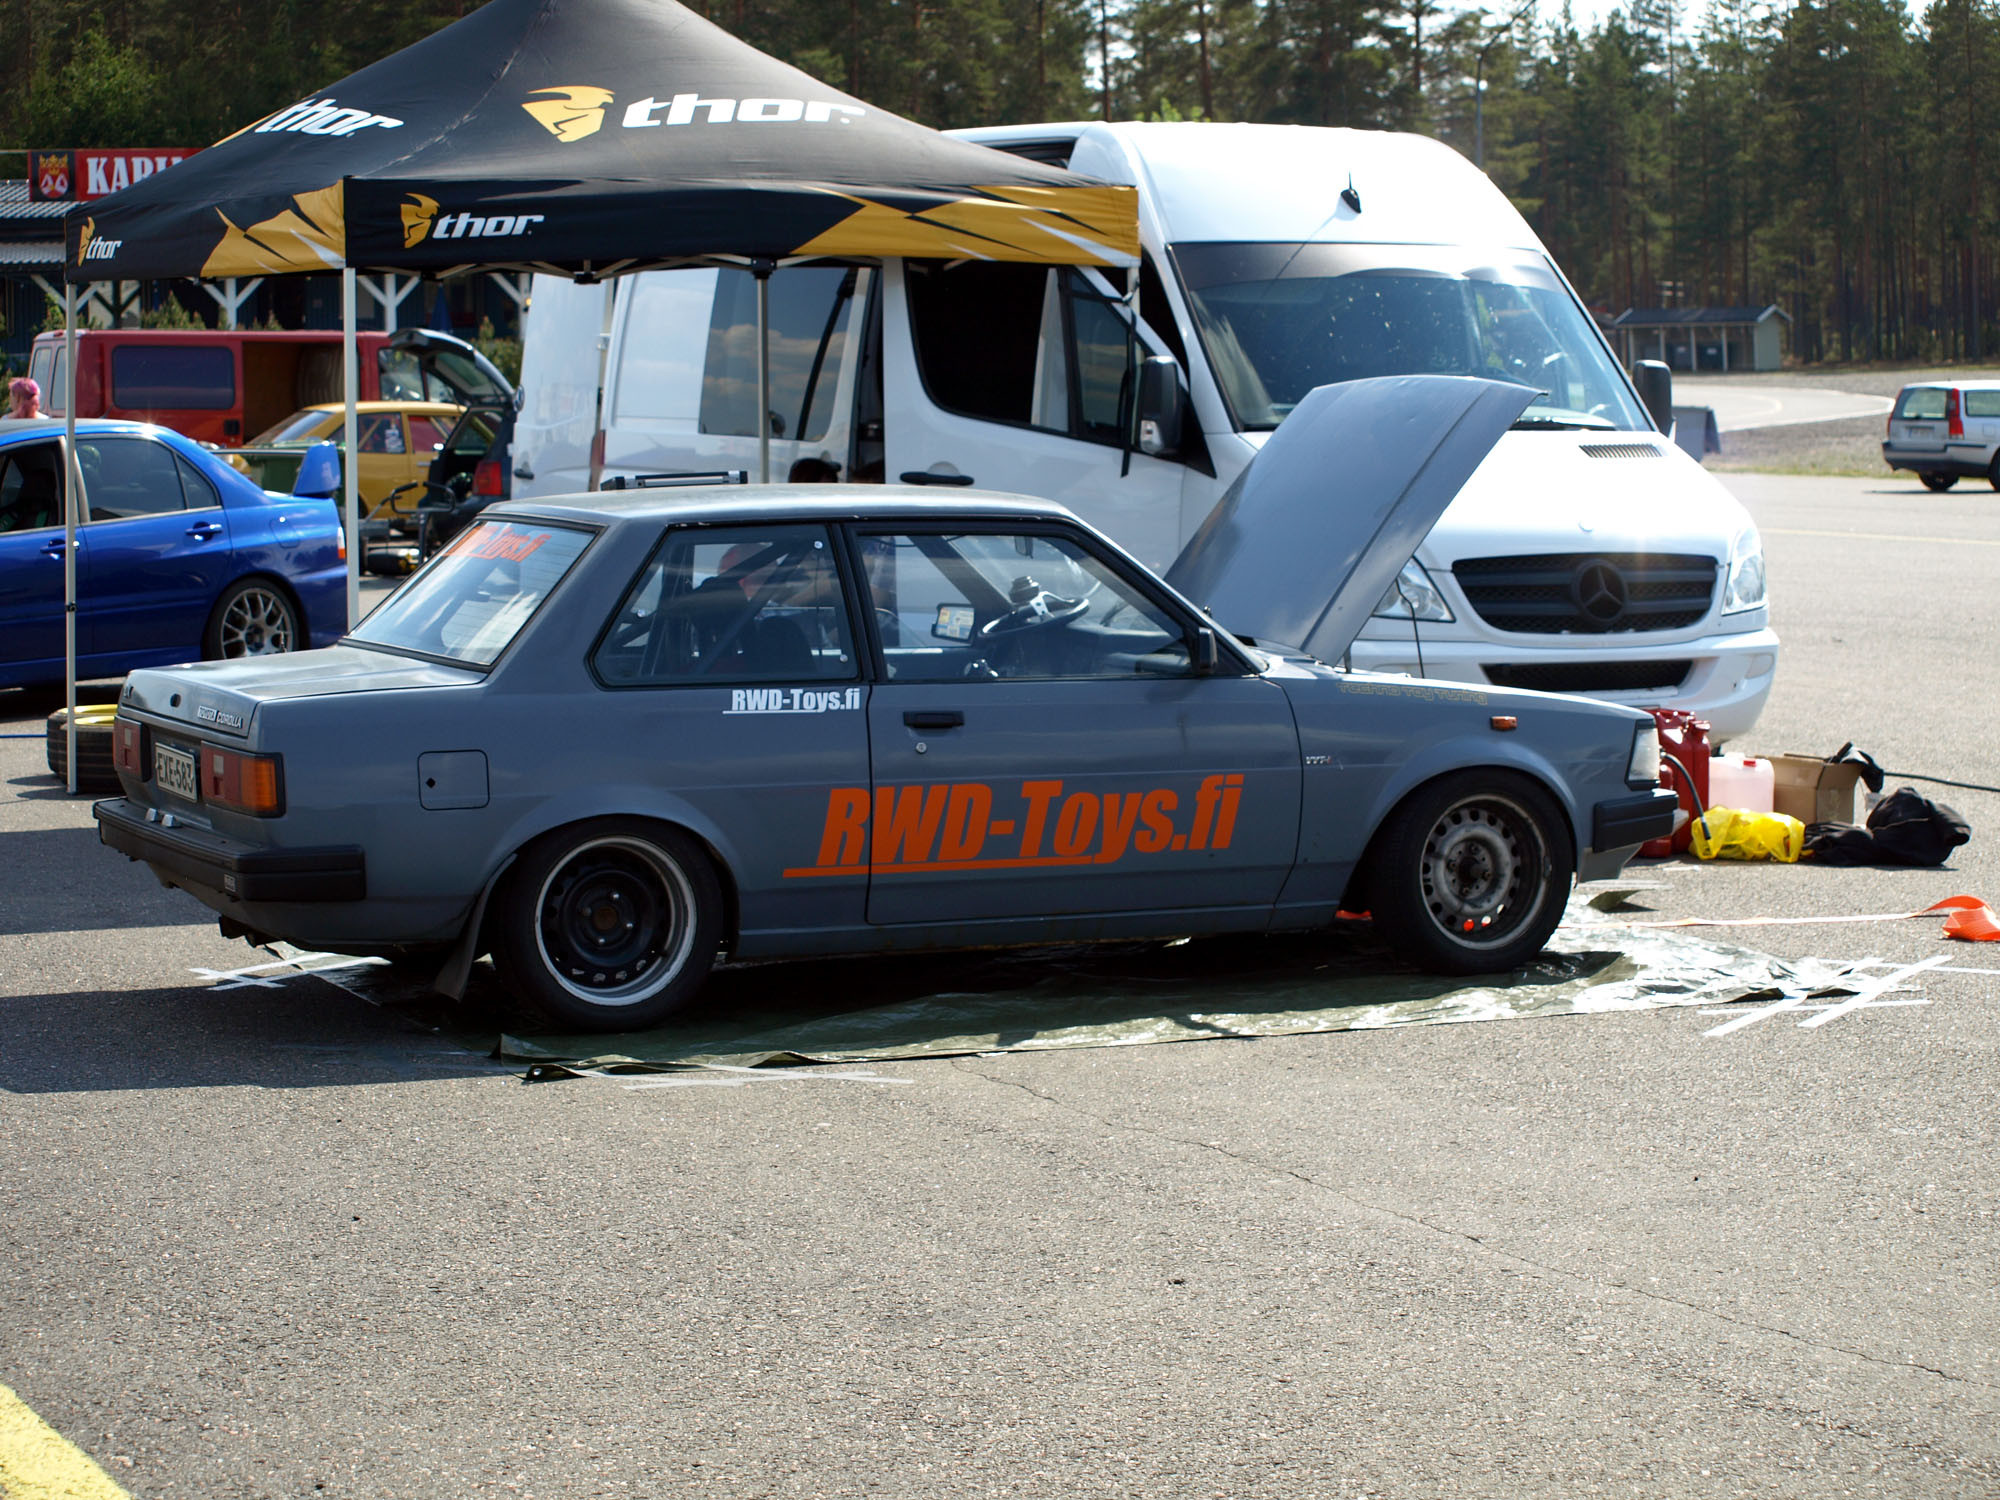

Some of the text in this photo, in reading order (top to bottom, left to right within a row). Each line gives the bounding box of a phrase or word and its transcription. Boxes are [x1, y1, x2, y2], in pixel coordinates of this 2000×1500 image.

[254, 98, 404, 138] thor
[622, 93, 866, 128] thor
[432, 212, 545, 239] thor
[86, 235, 122, 259] thor
[731, 688, 861, 713] RWD-Toys.fi
[157, 751, 194, 793] EXE-583
[815, 774, 1245, 864] RWD-Toys.fi
